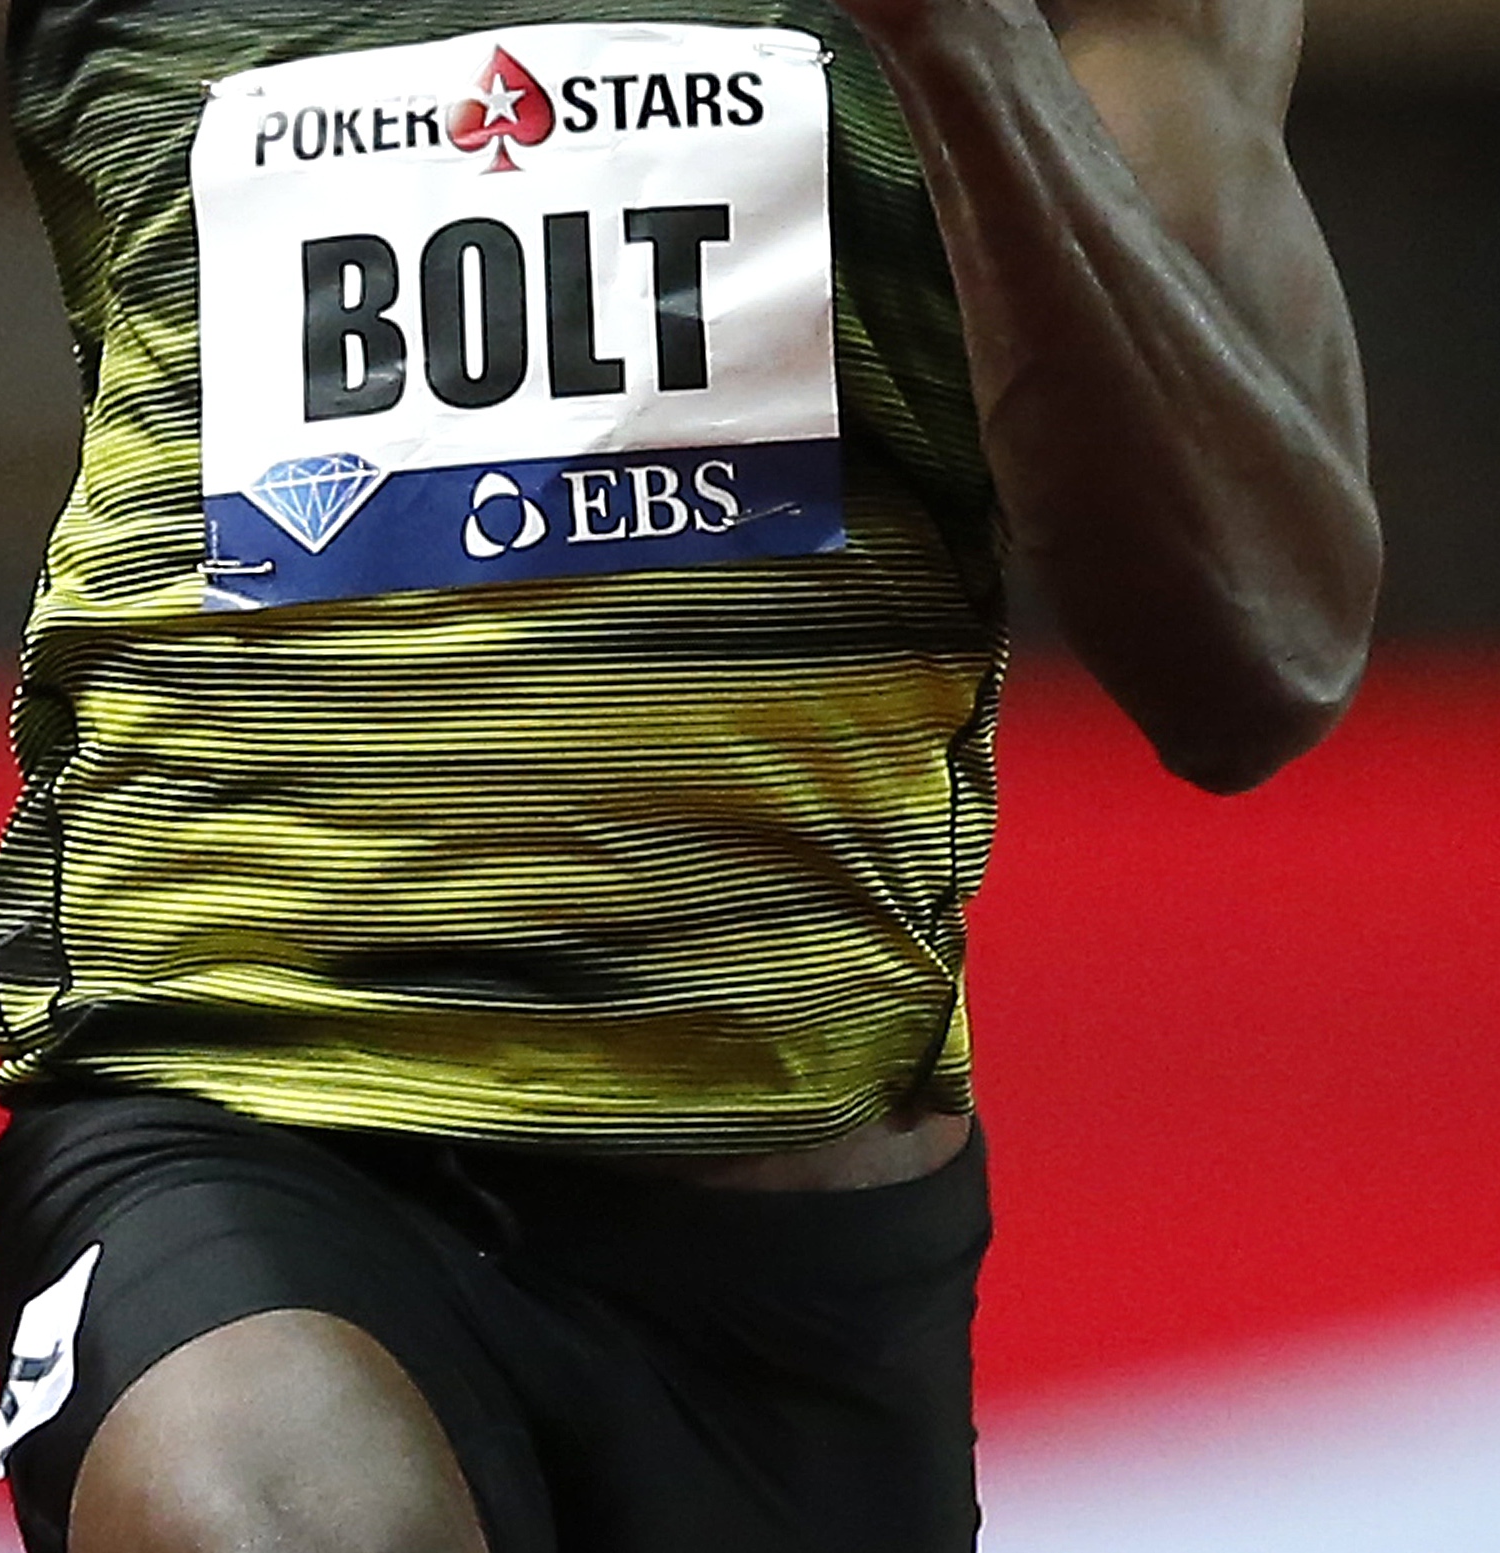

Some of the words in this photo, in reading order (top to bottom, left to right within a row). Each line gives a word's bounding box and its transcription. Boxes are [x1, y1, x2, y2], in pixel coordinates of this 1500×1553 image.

[254, 95, 440, 167] POKER
[562, 71, 764, 133] STARS
[301, 204, 730, 423] BOLT
[562, 460, 740, 546] EBS
